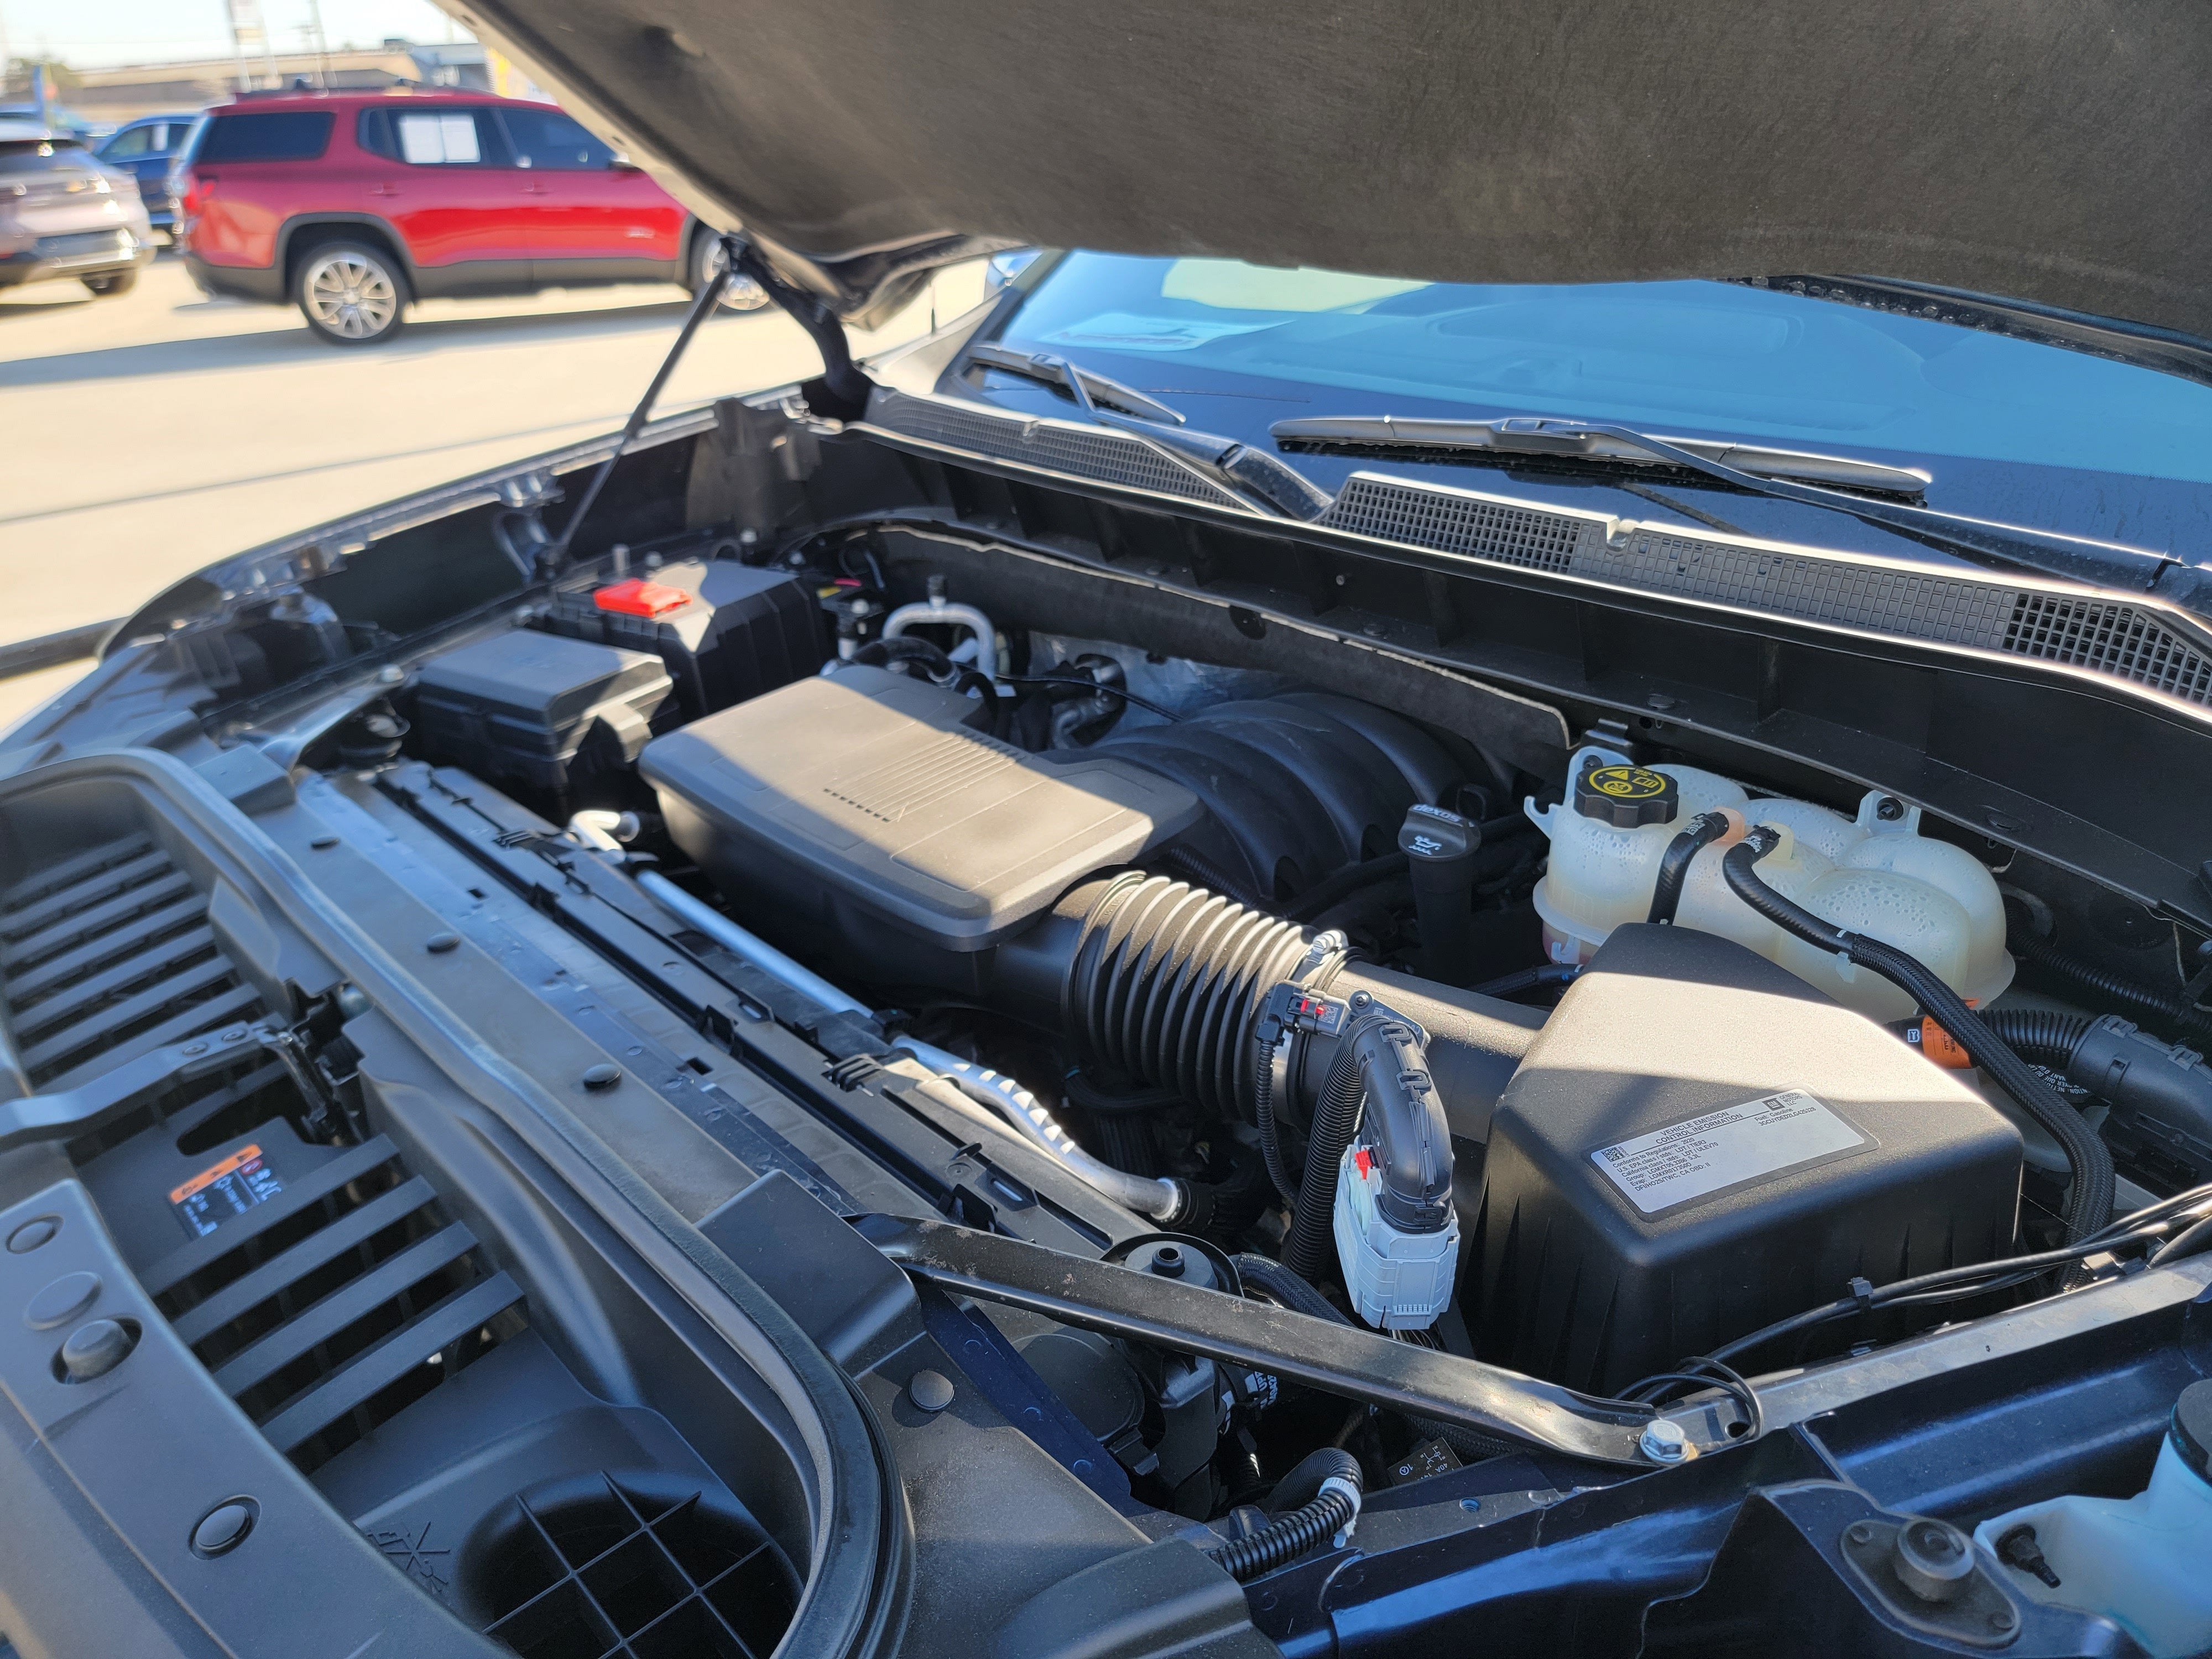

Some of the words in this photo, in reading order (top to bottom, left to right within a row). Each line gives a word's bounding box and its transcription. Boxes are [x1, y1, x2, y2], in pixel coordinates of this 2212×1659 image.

[1412, 805, 1462, 822] dexos
[1770, 1108, 1793, 1117] Gasoline
[1655, 1129, 1693, 1144] CONTROL
[1691, 1113, 1743, 1132] INFORMATION
[1660, 1123, 1693, 1136] VEHICLE
[1692, 1111, 1729, 1125] EMISSION
[1611, 1156, 1640, 1167] Conforms
[1645, 1142, 1681, 1156] Regulations:
[1620, 1165, 1649, 1177] California
[1695, 1142, 1719, 1151] ULEV70
[1688, 1164, 1706, 1172] OBD:
[1625, 1172, 1647, 1182] Group:
[1630, 1178, 1648, 1187] Evap:
[1435, 1463, 1448, 1473] 40A
